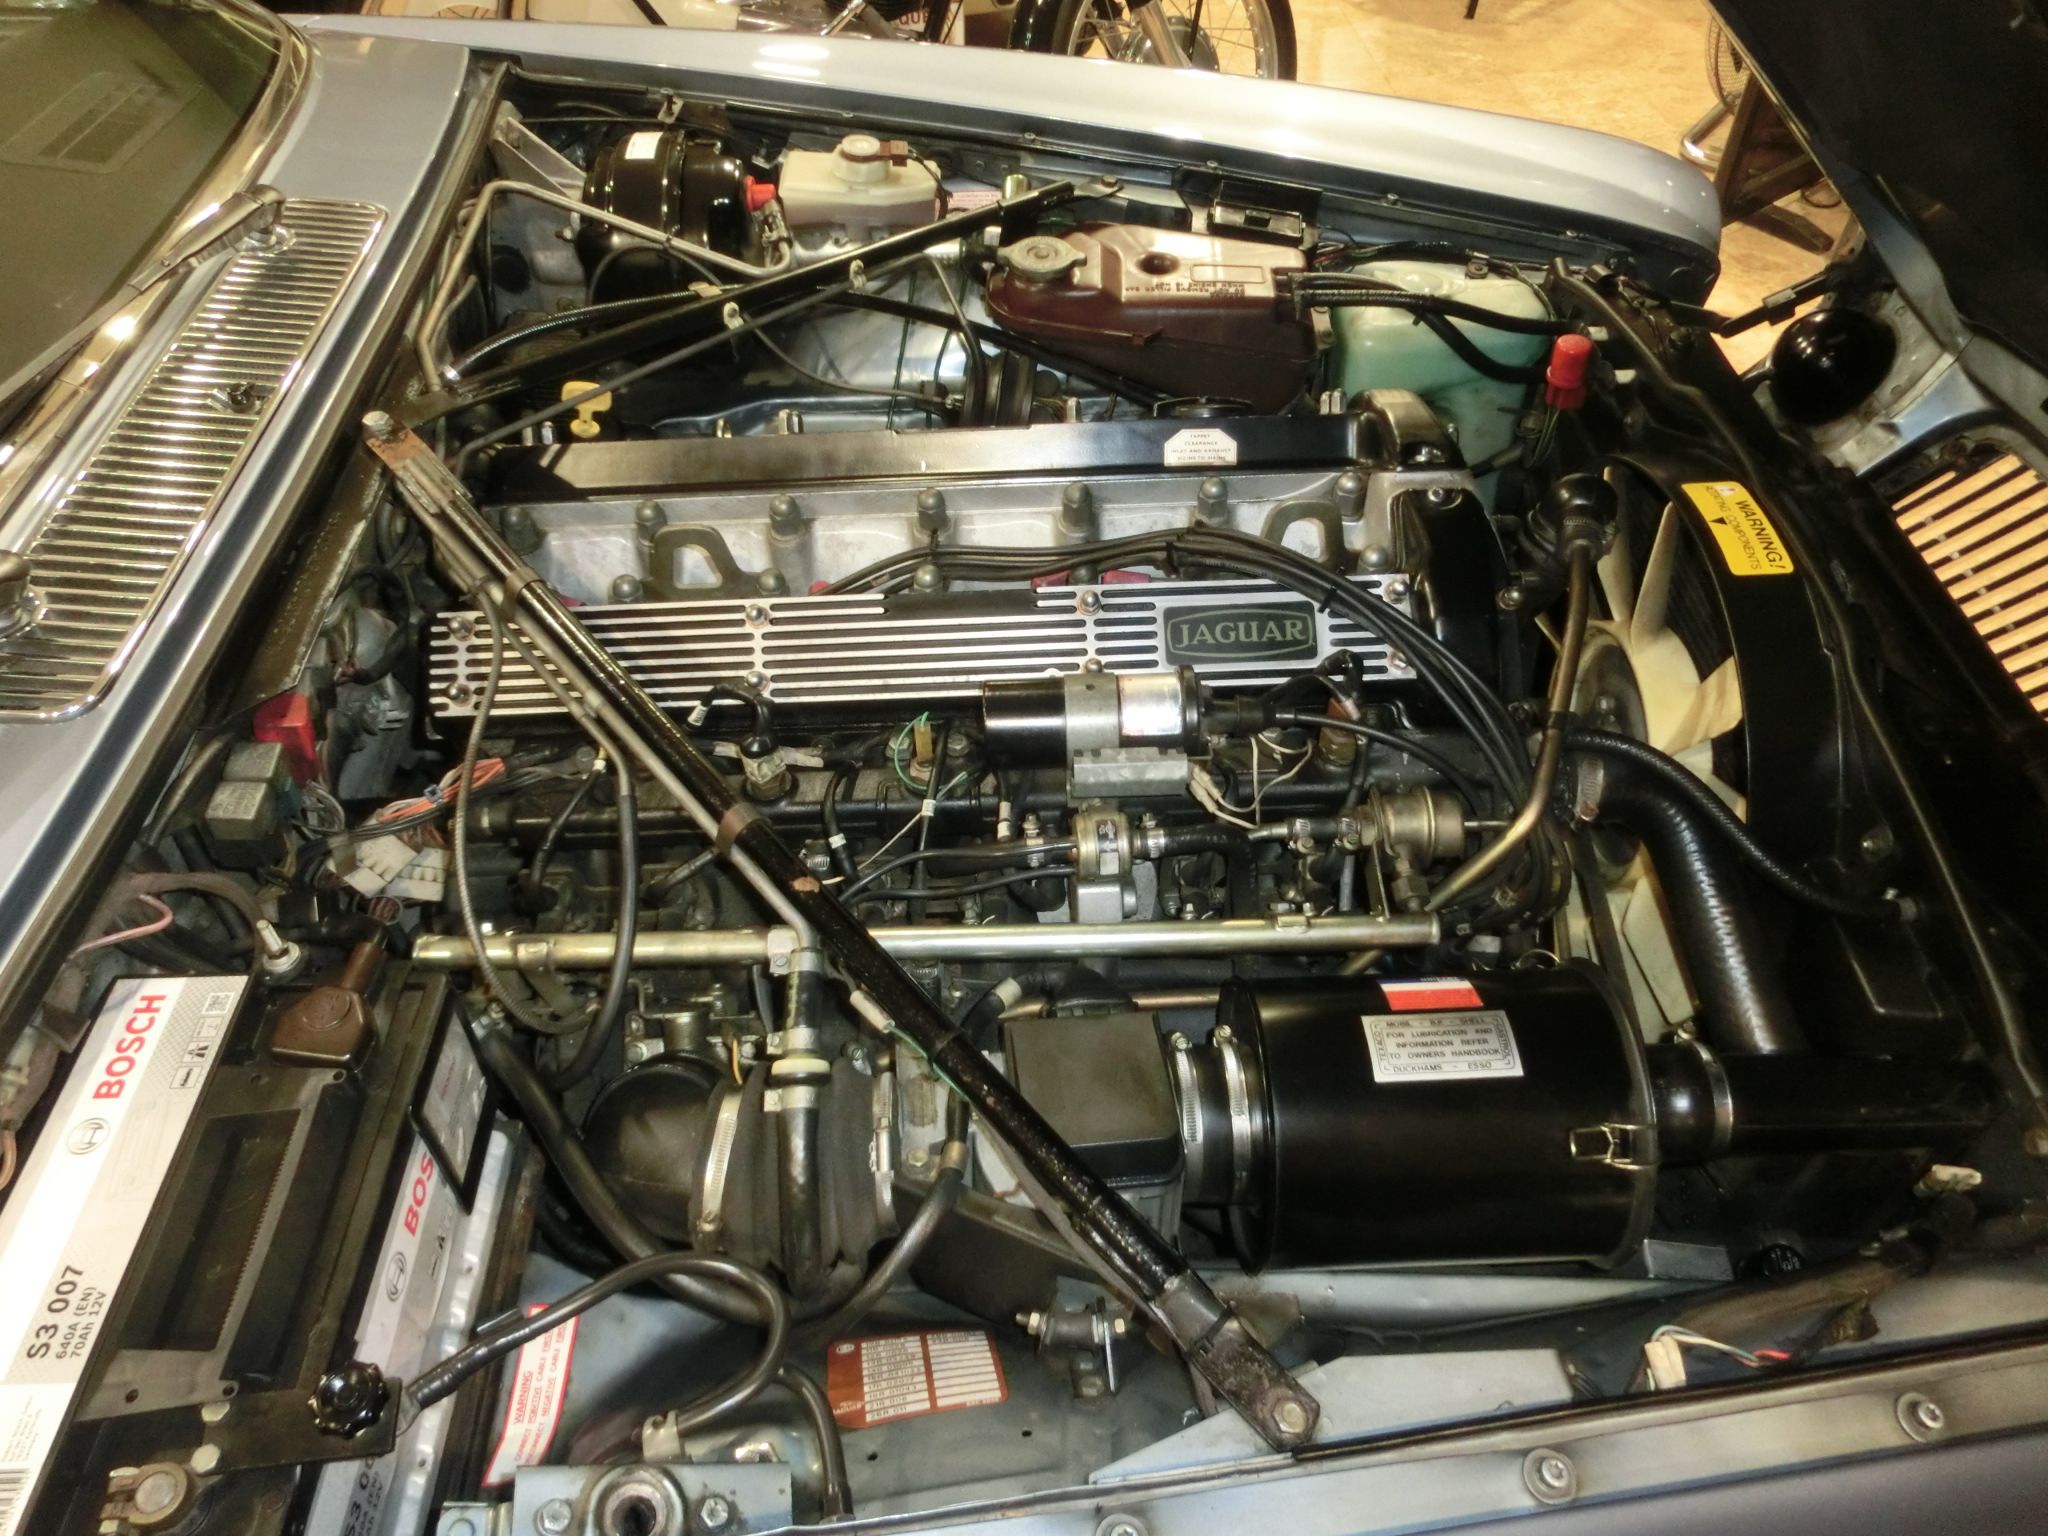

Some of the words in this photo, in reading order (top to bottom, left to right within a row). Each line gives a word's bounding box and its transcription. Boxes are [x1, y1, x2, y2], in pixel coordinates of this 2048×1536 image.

[1726, 514, 1762, 570] COMPONENTS
[1736, 500, 1786, 569] WARNING!
[1175, 619, 1307, 648] JAGUAR
[92, 994, 168, 1099] BOSCH
[1396, 1040, 1454, 1048] INFORMATION
[1460, 1038, 1489, 1046] REFER
[1408, 1050, 1446, 1059] OWNERS
[1452, 1048, 1501, 1057] HANDBOOK
[1411, 1029, 1468, 1038] LUBRICATION
[1393, 1064, 1443, 1072] DUCKHAMS
[1468, 1062, 1492, 1070] ESSO
[404, 1151, 434, 1237] BOS
[26, 1323, 58, 1359] S3
[47, 1265, 84, 1313] 007
[56, 1322, 80, 1360] 640A
[73, 1286, 96, 1317] (EN)
[69, 1322, 94, 1359] 70Ah
[88, 1291, 107, 1316] 12V
[512, 1371, 532, 1424] WARNING
[528, 1386, 542, 1424] POSITIVE
[536, 1358, 547, 1382] CABLE
[542, 1376, 556, 1417] NEGATIVE
[550, 1348, 560, 1372] CABLE
[360, 1456, 376, 1490] 00
